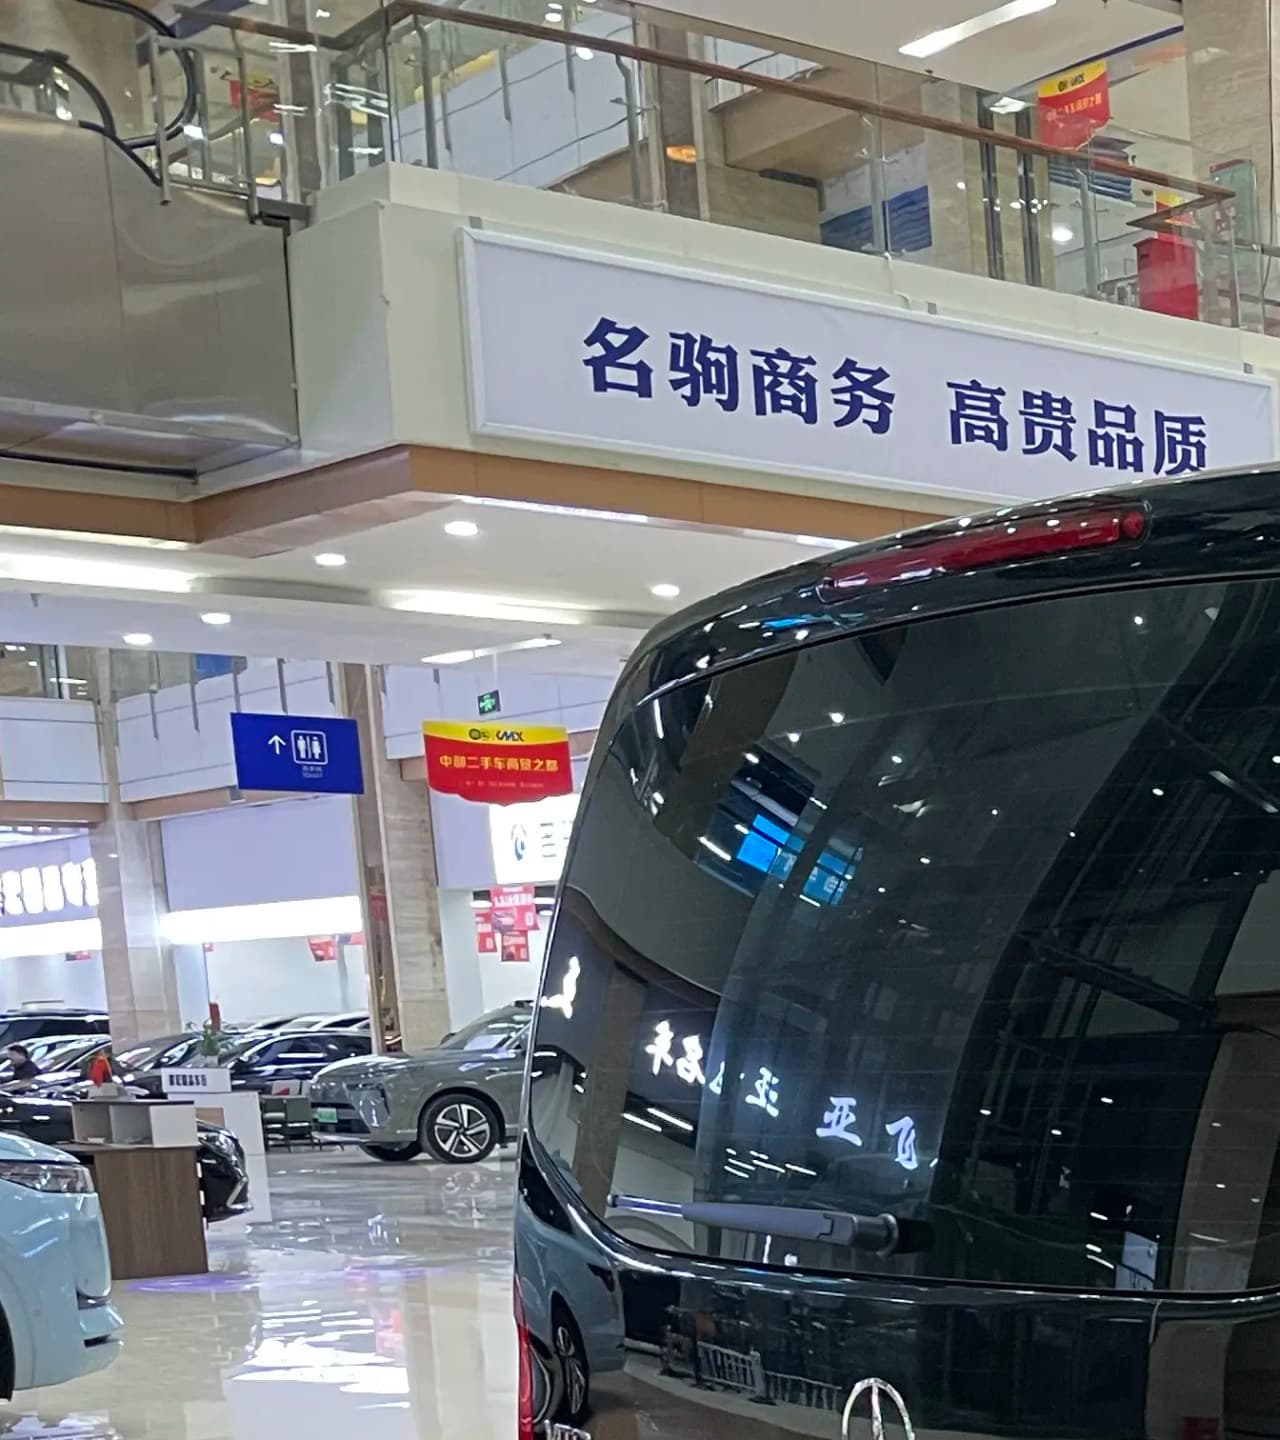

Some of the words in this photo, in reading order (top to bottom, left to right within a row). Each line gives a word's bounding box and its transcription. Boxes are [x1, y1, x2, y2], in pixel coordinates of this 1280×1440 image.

[581, 315, 897, 435] 名驹商务
[946, 378, 1209, 476] 高贵品质
